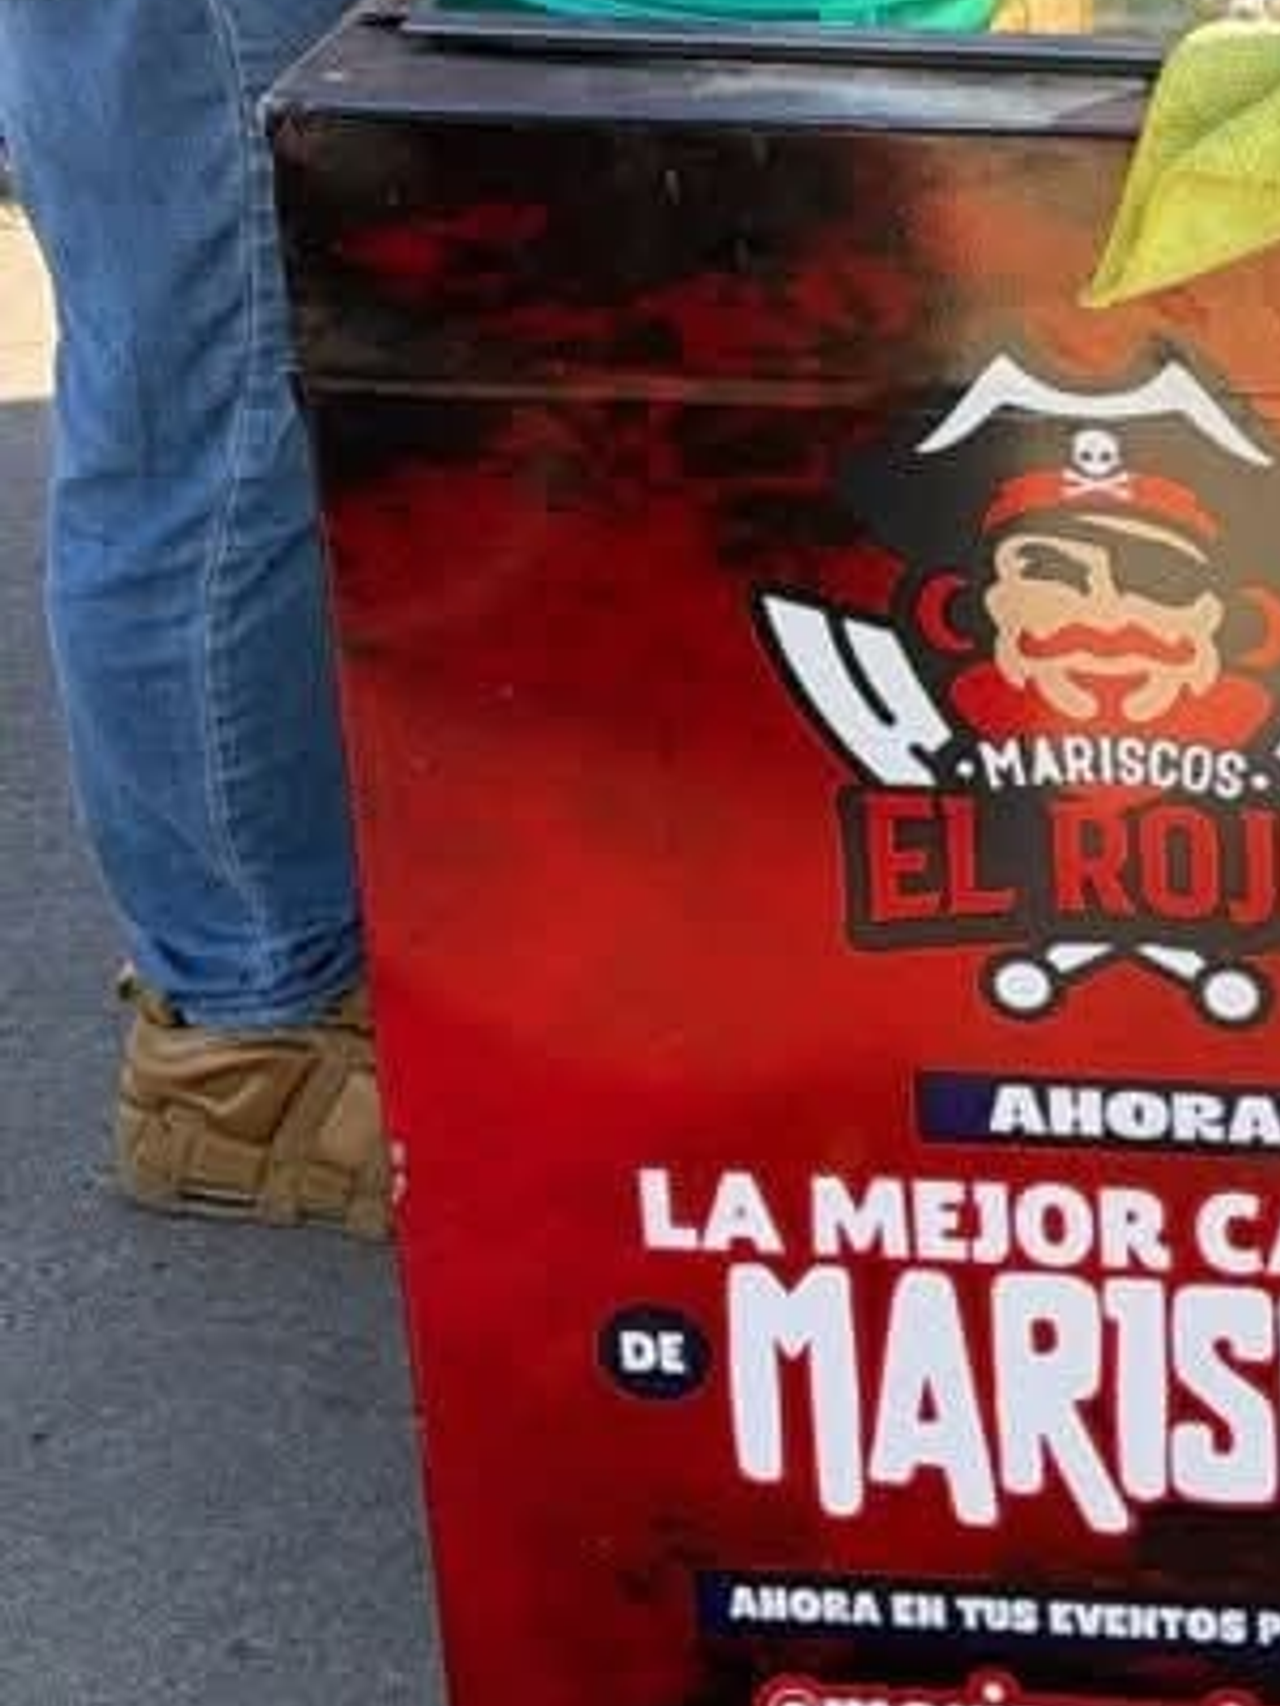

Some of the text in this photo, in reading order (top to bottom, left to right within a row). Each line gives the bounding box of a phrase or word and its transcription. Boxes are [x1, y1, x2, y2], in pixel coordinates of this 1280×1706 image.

[976, 736, 1248, 798] MARISCOS
[861, 792, 1014, 923] EL
[637, 1168, 785, 1254] LA
[810, 1175, 1172, 1271] MEJOR
[617, 1330, 686, 1374] DE
[729, 1585, 882, 1626] AHORA
[891, 1593, 947, 1628] EN
[956, 1596, 1039, 1634] TUS
[1048, 1601, 1247, 1644] EVENTOS
